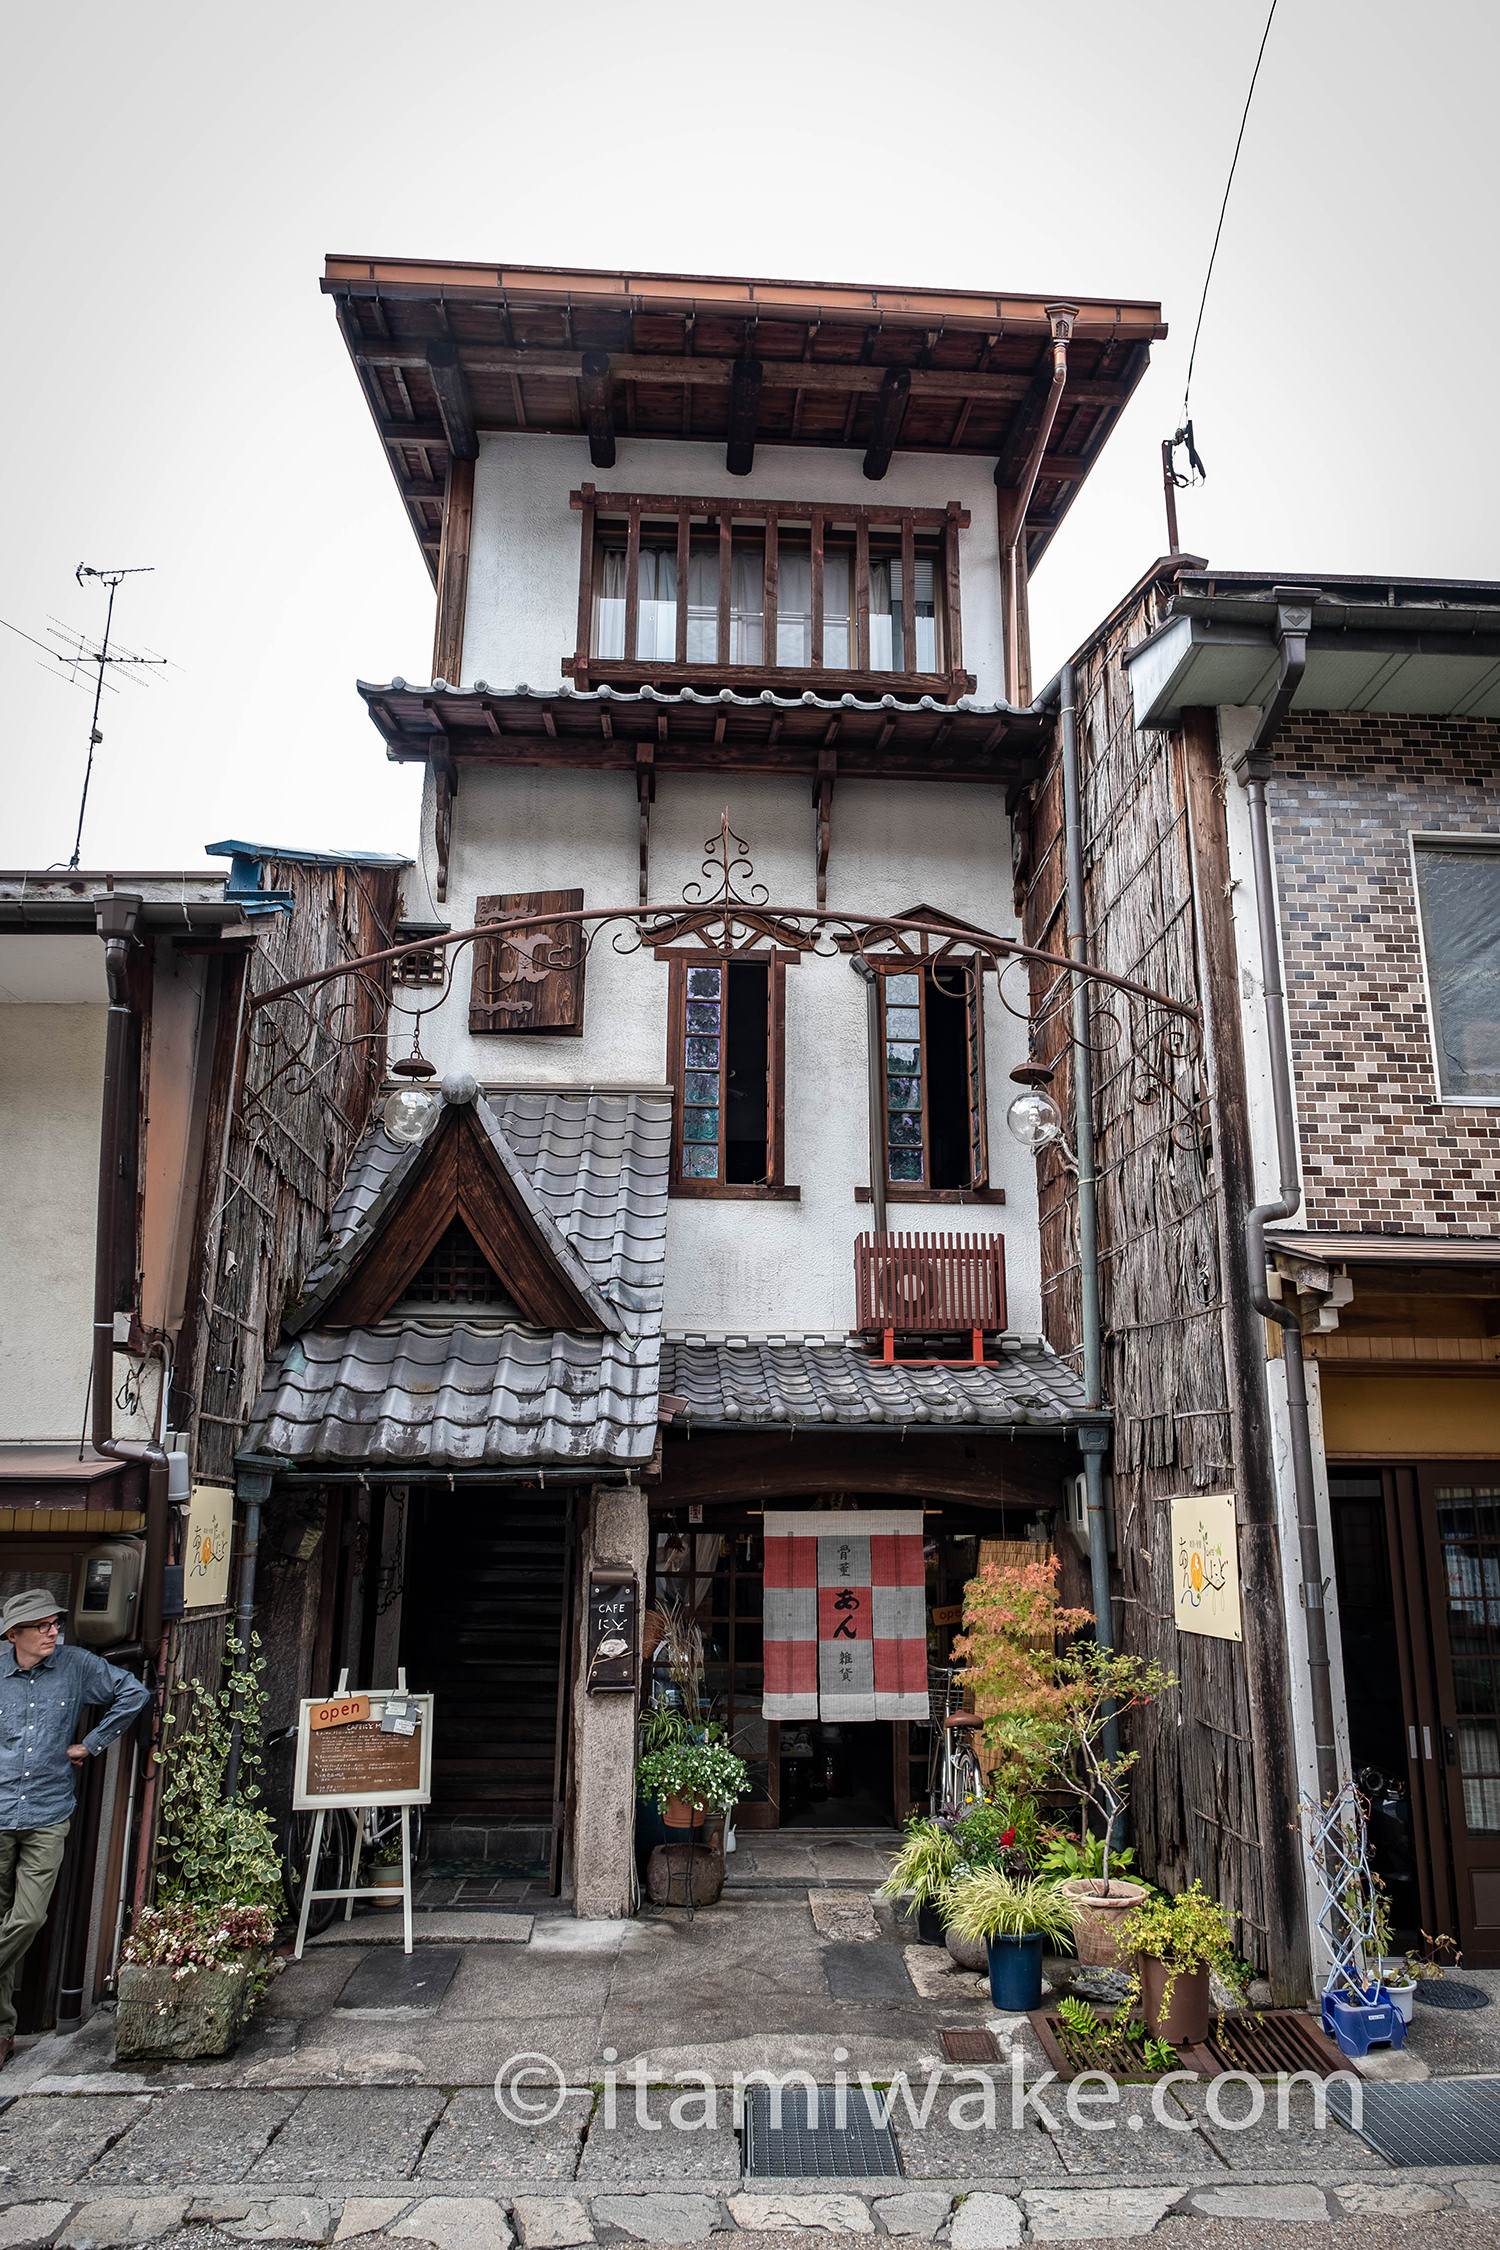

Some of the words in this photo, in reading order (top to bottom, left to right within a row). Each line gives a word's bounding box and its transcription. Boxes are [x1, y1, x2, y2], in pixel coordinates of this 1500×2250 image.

[837, 1544, 851, 1577] 骨董
[599, 1604, 625, 1613] CAFE
[833, 1588, 860, 1639] あん
[939, 1608, 961, 1622] ope
[598, 1618, 628, 1631] にど
[320, 1703, 360, 1722] open
